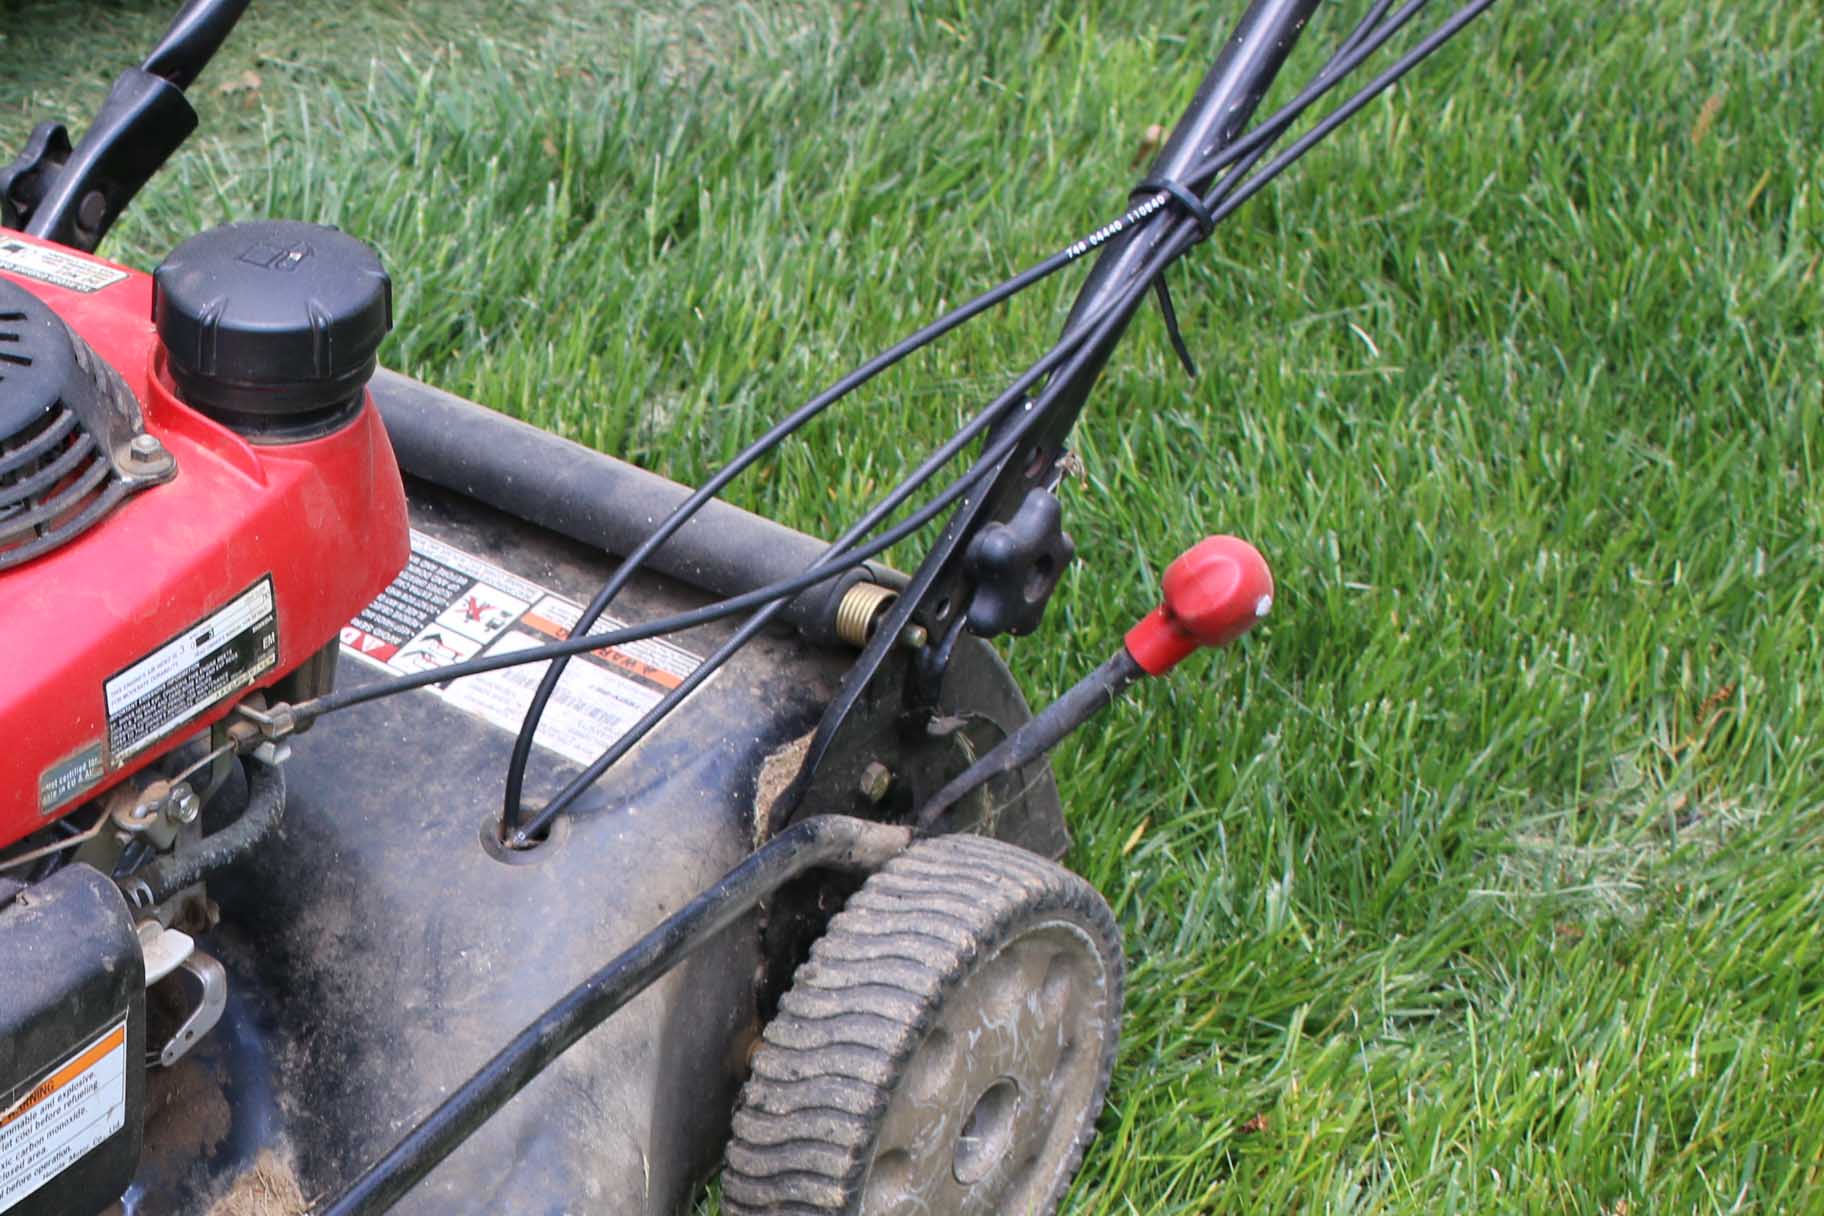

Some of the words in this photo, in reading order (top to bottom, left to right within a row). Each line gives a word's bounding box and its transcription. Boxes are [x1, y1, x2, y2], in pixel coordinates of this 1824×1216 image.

[40, 1097, 55, 1113] and
[1, 1139, 14, 1153] let
[15, 1123, 33, 1142] cool
[35, 1106, 62, 1129] before
[15, 1136, 45, 1161] carbon
[5, 1172, 33, 1196] before
